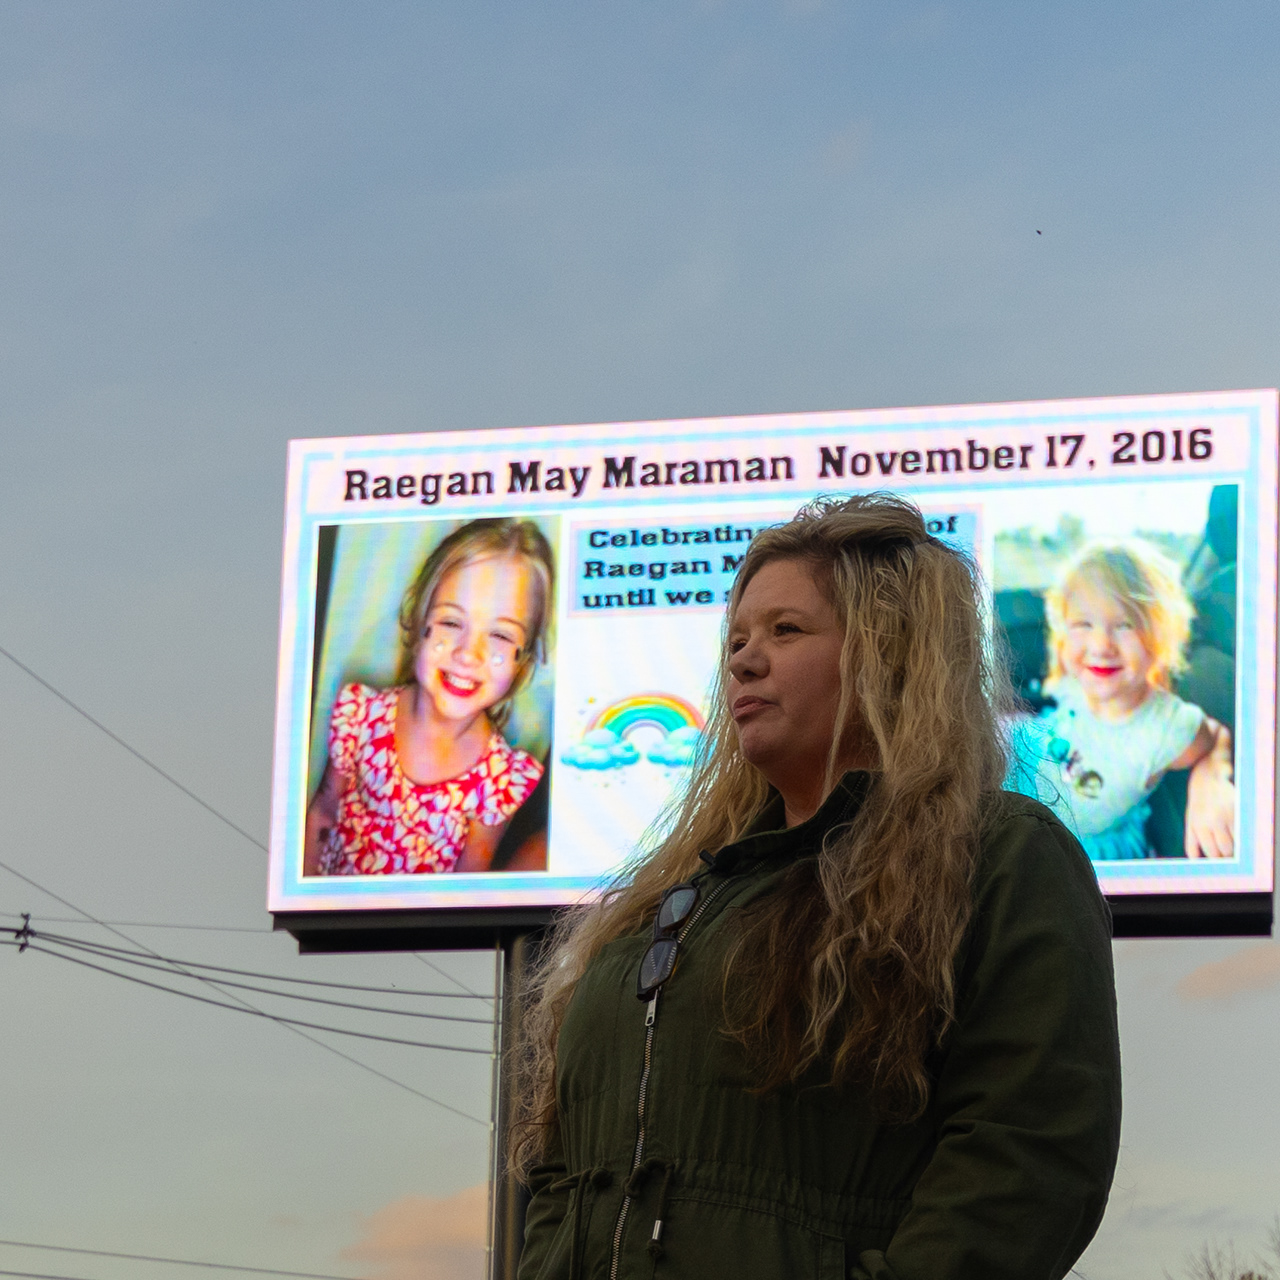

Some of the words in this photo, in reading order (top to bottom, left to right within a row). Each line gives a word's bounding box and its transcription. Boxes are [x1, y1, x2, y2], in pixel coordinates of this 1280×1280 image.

[344, 468, 495, 505] Raegan
[507, 460, 591, 497] May
[603, 454, 795, 488] Maraman
[819, 439, 1033, 478] November
[1046, 433, 1096, 470] 17,
[1111, 427, 1214, 464] 2016
[589, 525, 763, 548] Celebratin
[927, 515, 959, 533] of
[584, 559, 712, 581] Raegan
[583, 588, 656, 609] until
[665, 589, 715, 605] we
